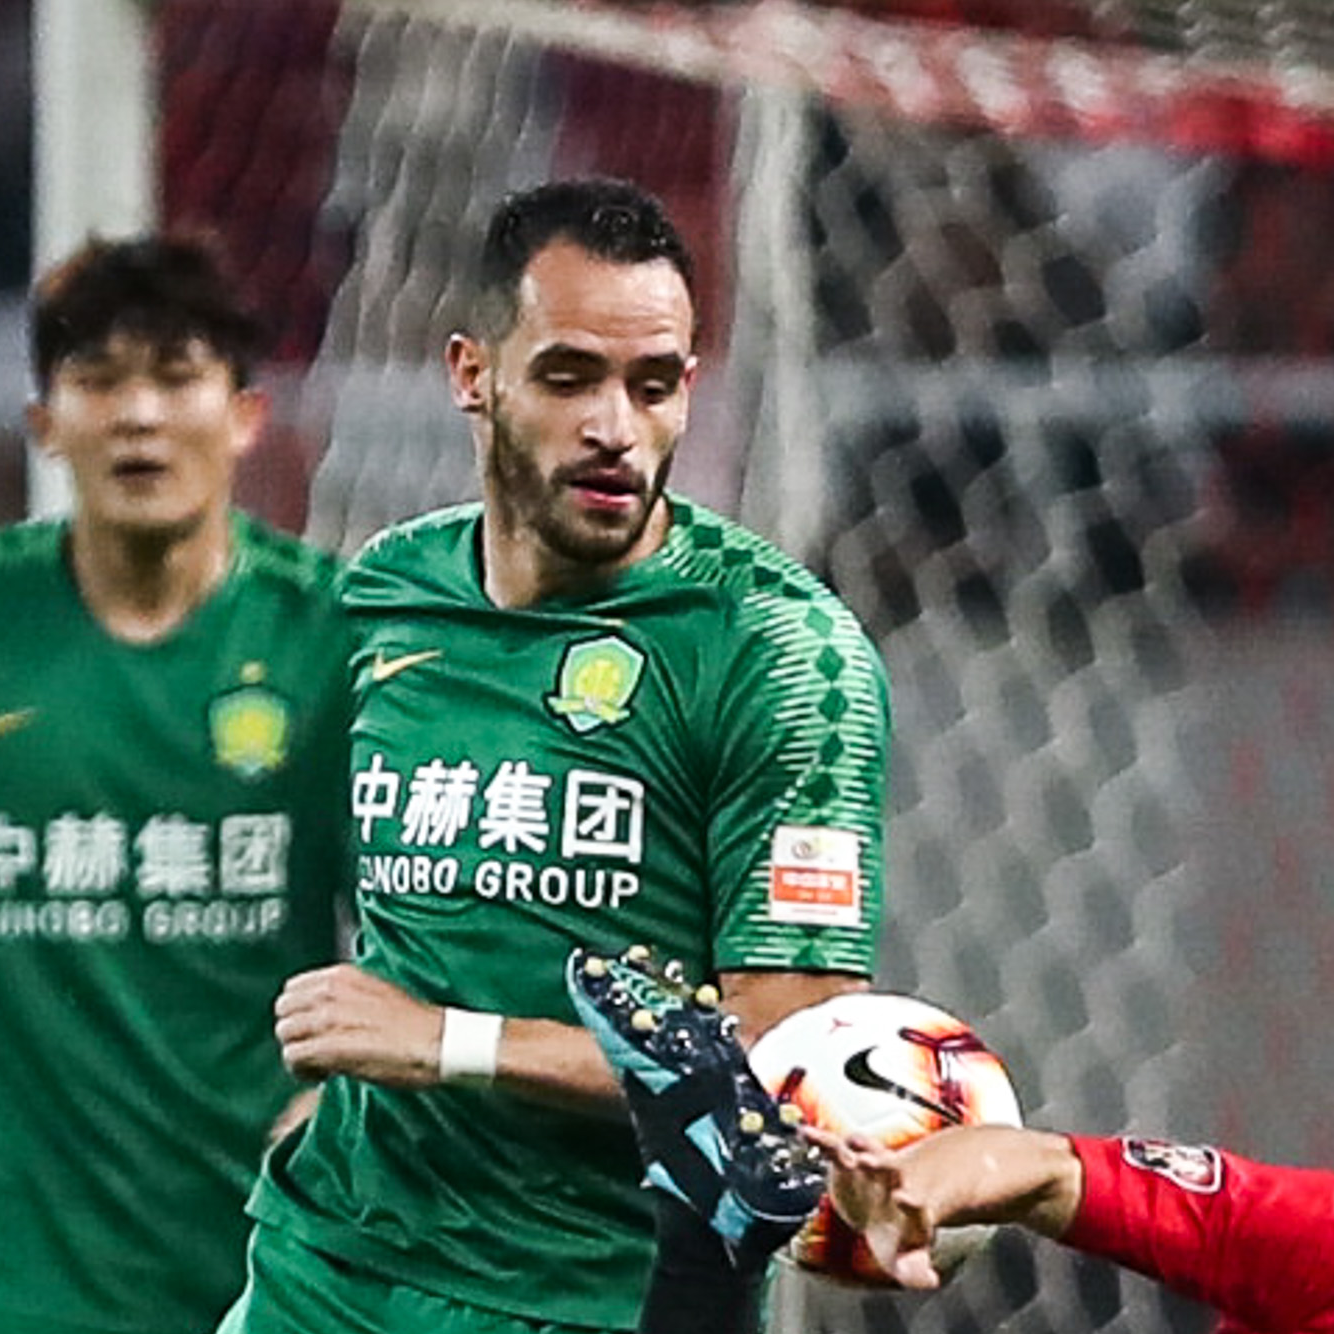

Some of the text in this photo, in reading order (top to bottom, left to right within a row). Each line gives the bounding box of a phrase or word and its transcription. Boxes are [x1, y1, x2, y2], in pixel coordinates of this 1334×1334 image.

[352, 752, 645, 864] 中赫集团
[474, 860, 640, 908] GROUP
